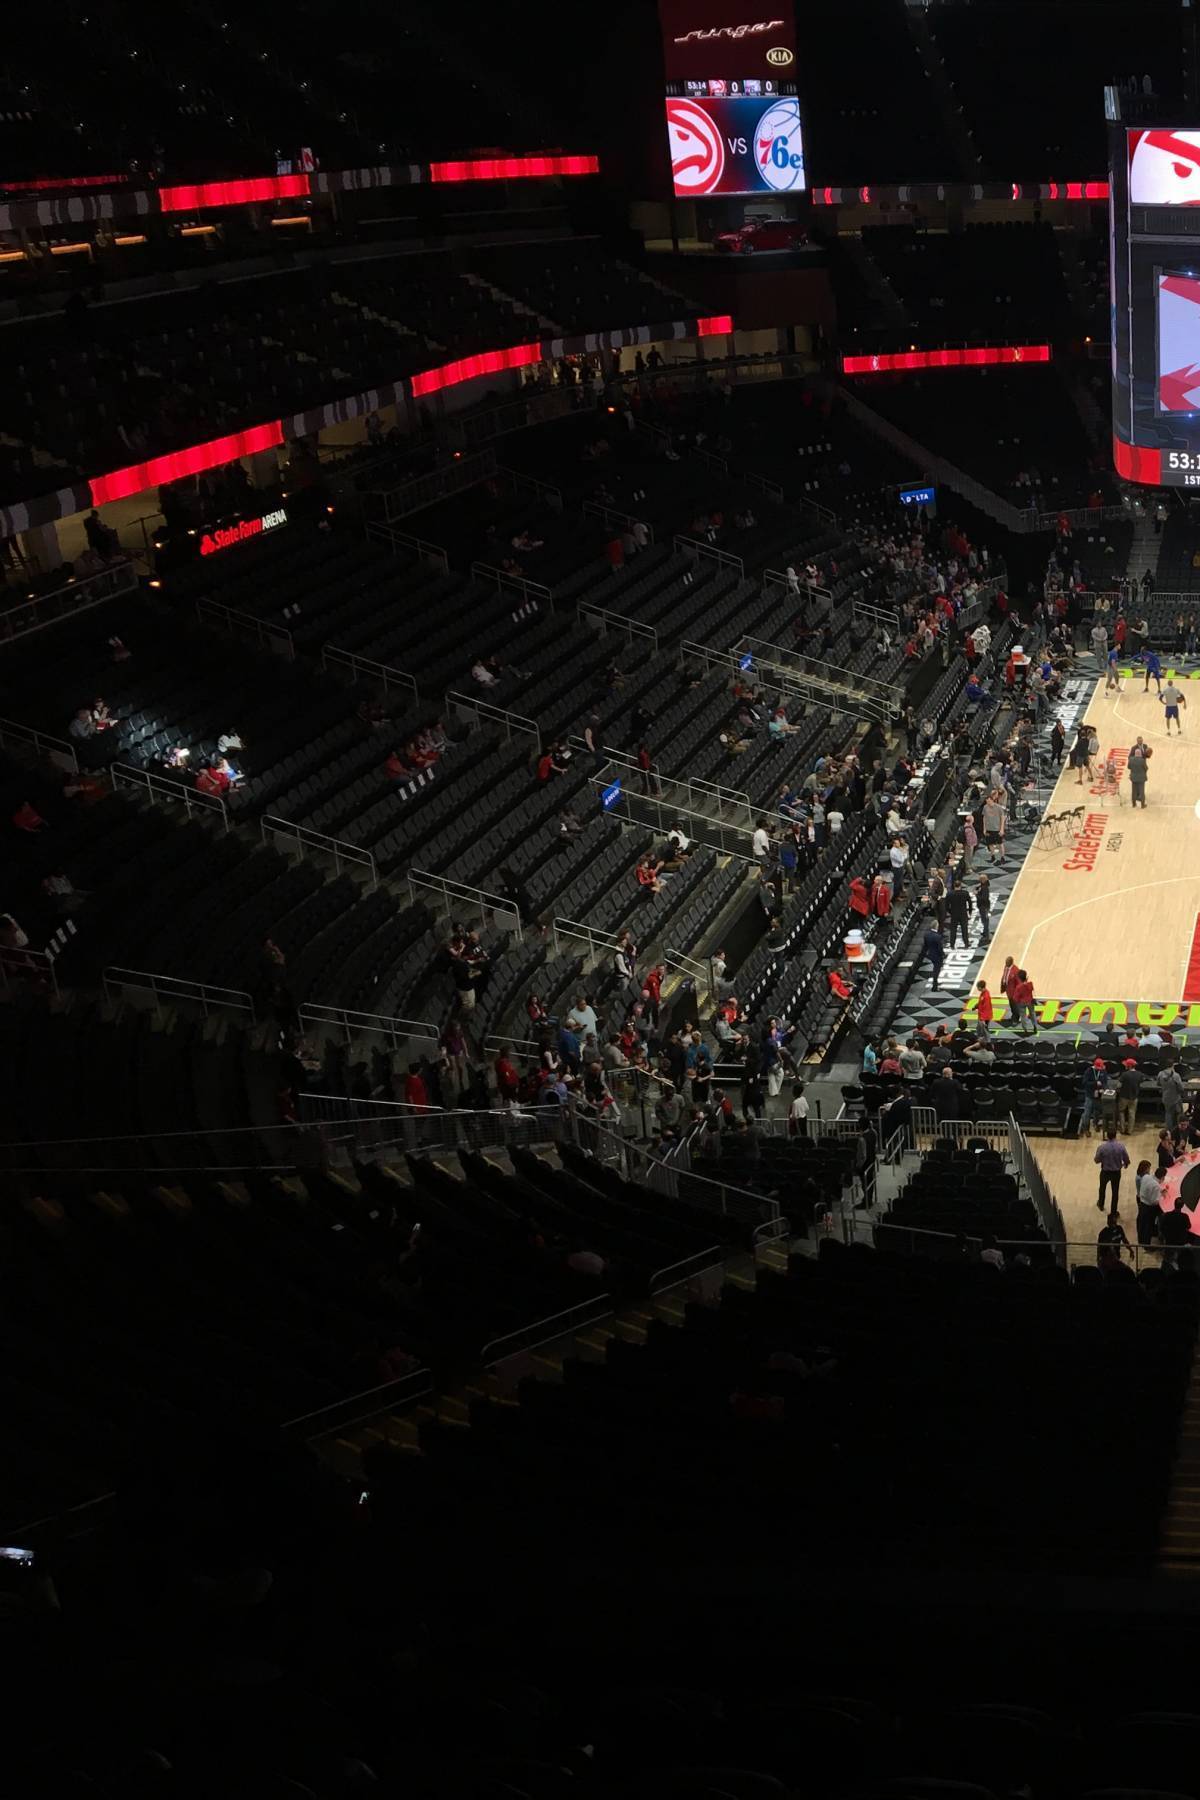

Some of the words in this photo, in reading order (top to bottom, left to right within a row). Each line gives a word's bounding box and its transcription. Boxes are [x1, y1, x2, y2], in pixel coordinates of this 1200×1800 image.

[769, 50, 790, 62] KIA
[732, 82, 738, 92] 0
[766, 81, 772, 91] 0
[728, 138, 747, 154] VS
[262, 509, 287, 530] ARENA
